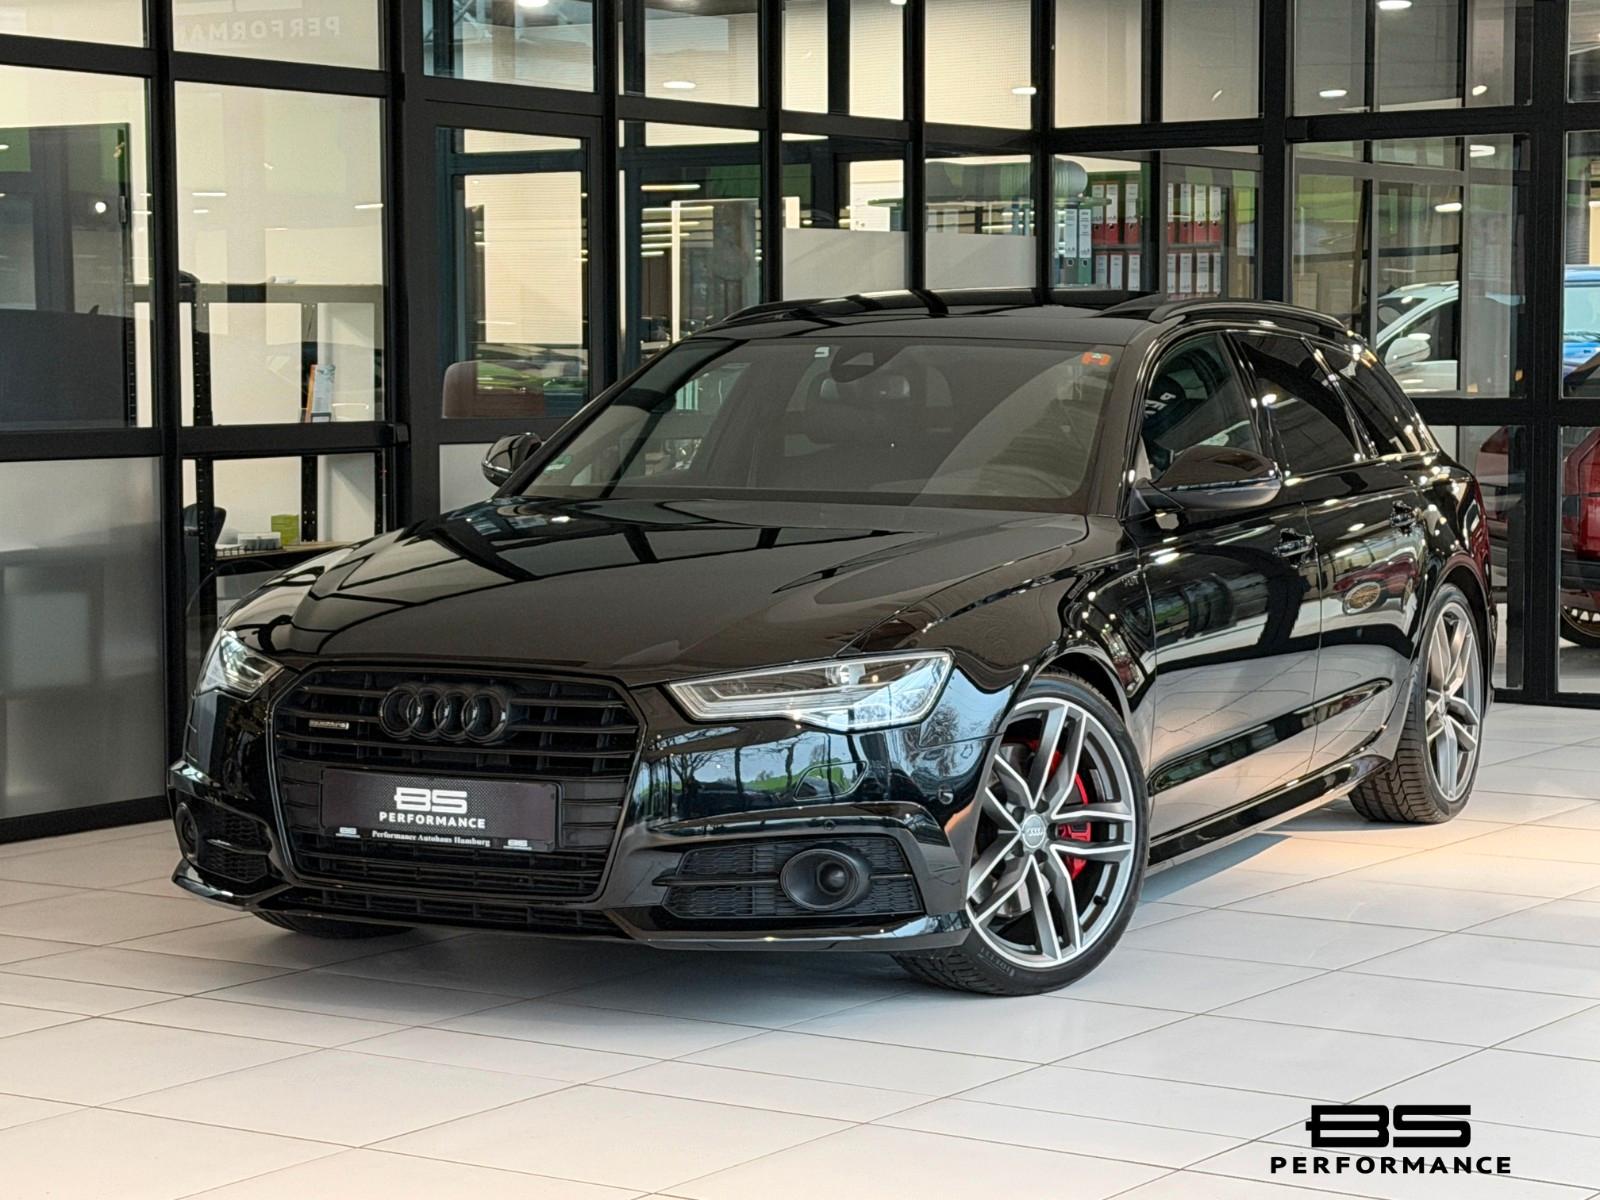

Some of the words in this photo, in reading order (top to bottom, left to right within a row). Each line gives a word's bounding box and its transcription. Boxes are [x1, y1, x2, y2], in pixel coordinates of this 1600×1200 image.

[394, 787, 467, 814] BS
[379, 811, 486, 829] PERFORMANCE
[372, 830, 417, 841] Performance
[417, 834, 452, 844] Autohaus
[454, 836, 491, 848] Hamburg
